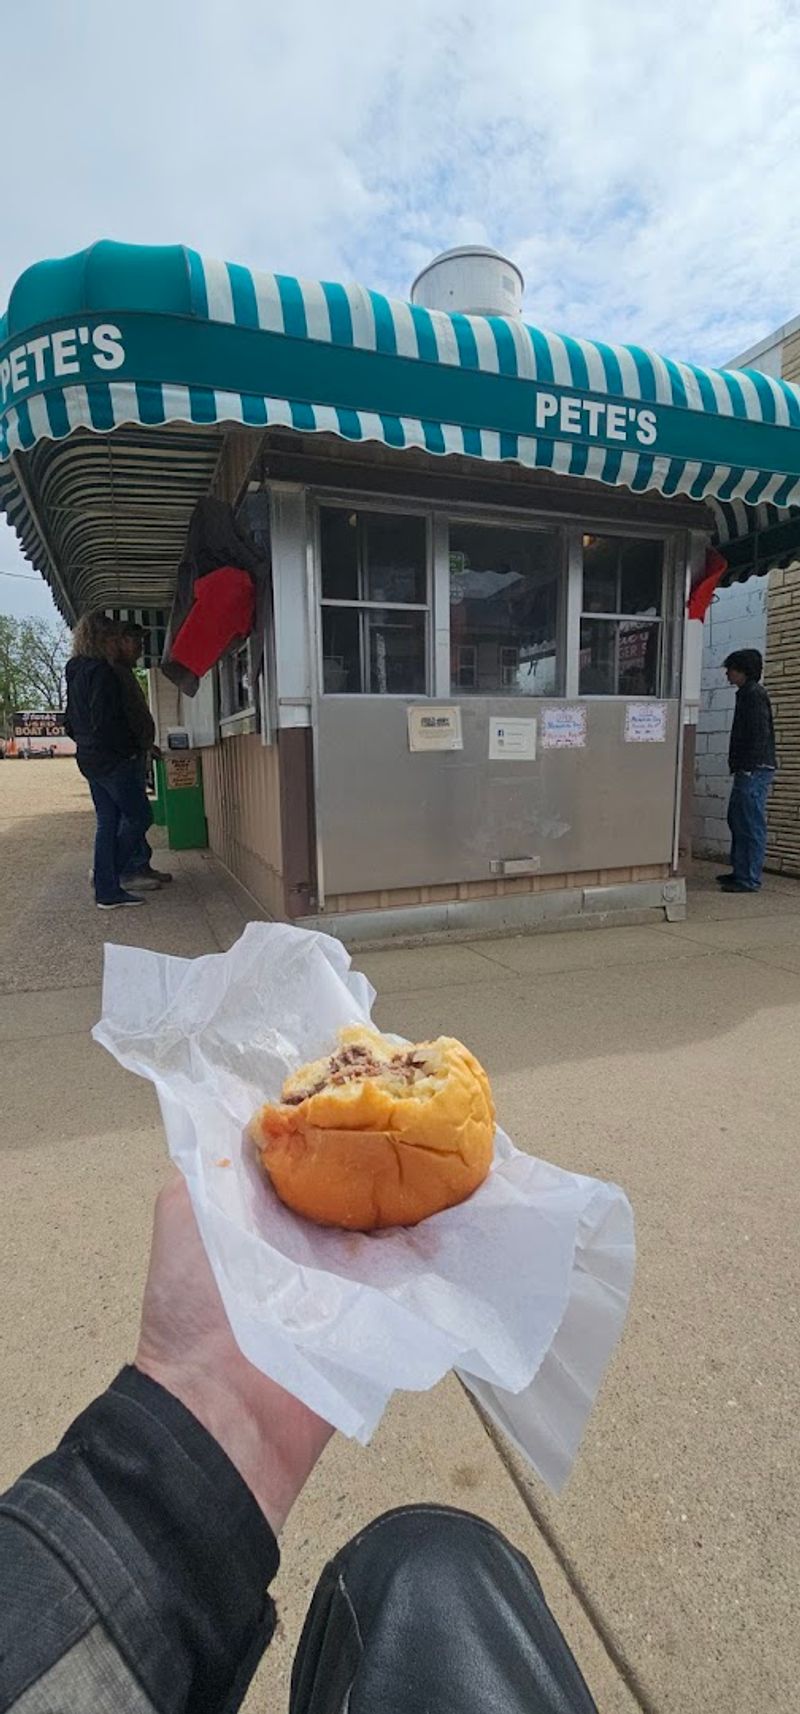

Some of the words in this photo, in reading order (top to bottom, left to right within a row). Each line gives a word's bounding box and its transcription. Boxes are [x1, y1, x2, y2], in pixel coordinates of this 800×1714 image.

[0, 324, 125, 404] PETE'S
[536, 392, 657, 445] PETE'S
[15, 726, 43, 736] BOAT
[46, 726, 66, 736] LOT
